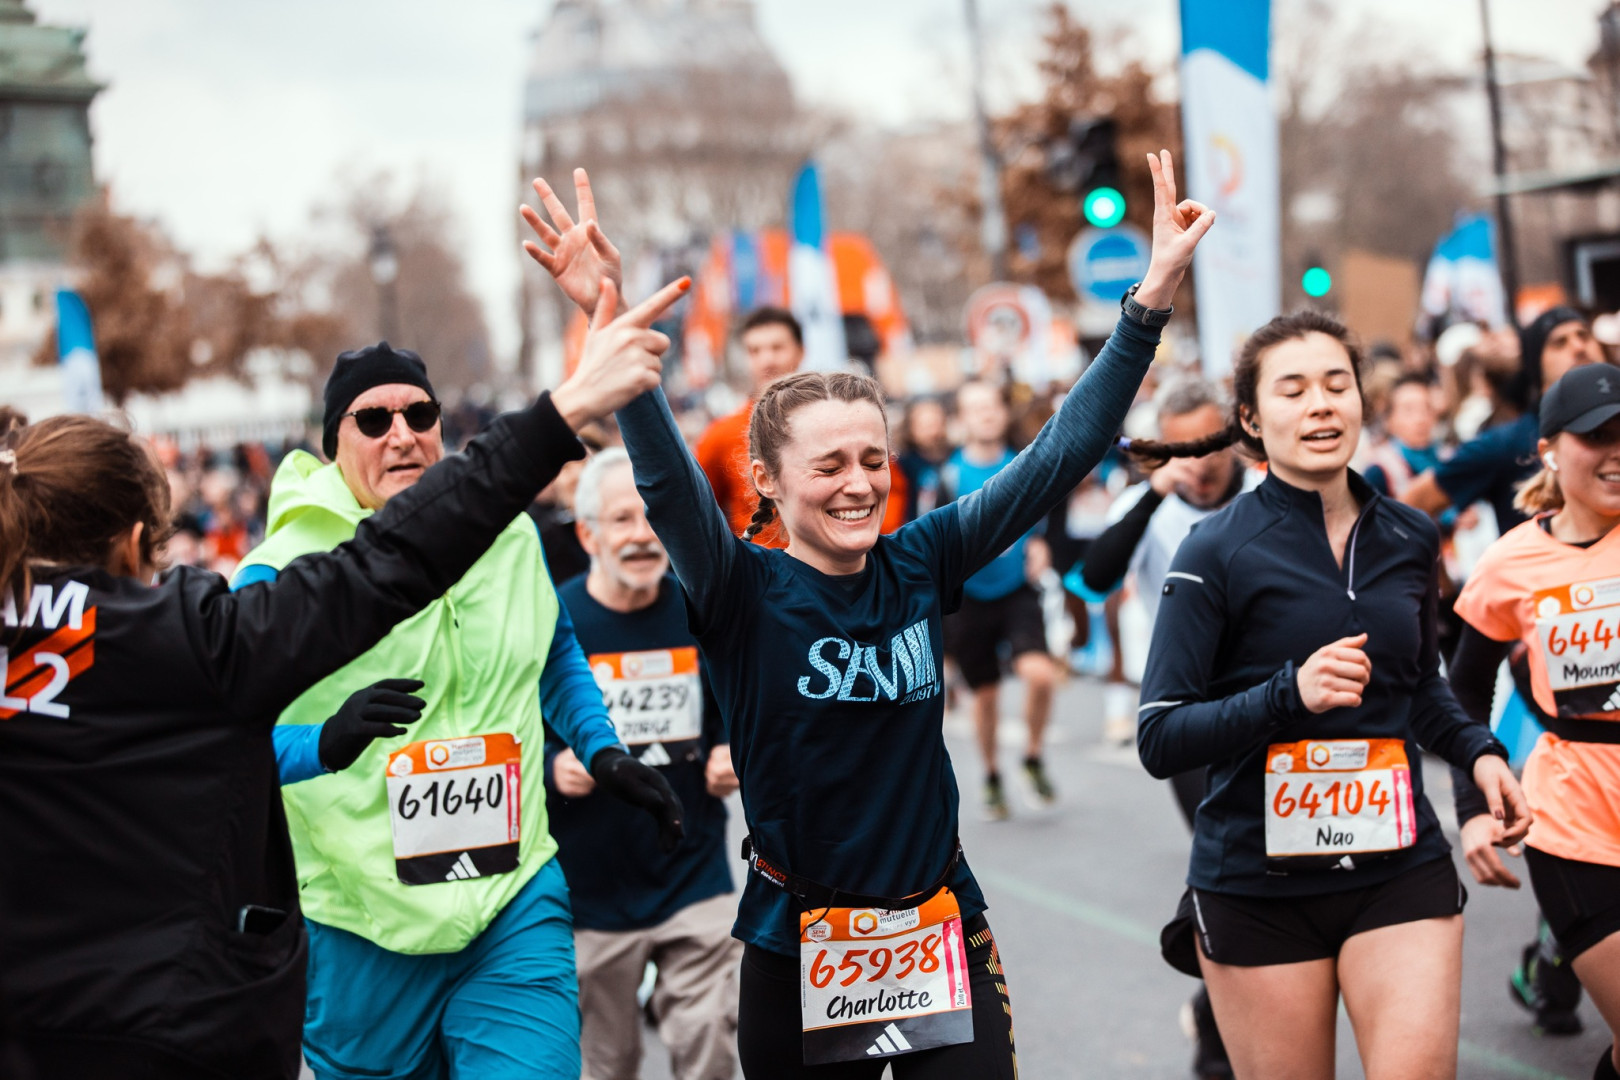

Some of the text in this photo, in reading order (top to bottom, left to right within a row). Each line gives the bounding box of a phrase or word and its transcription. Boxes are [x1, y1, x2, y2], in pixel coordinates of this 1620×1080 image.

[1547, 618, 1620, 657] 644
[397, 773, 504, 820] 61640
[1272, 779, 1391, 819] 64104
[1315, 824, 1354, 846] Nao
[879, 909, 916, 925] mutuelle
[809, 932, 943, 989] 65938
[826, 988, 933, 1020] Charlotte
